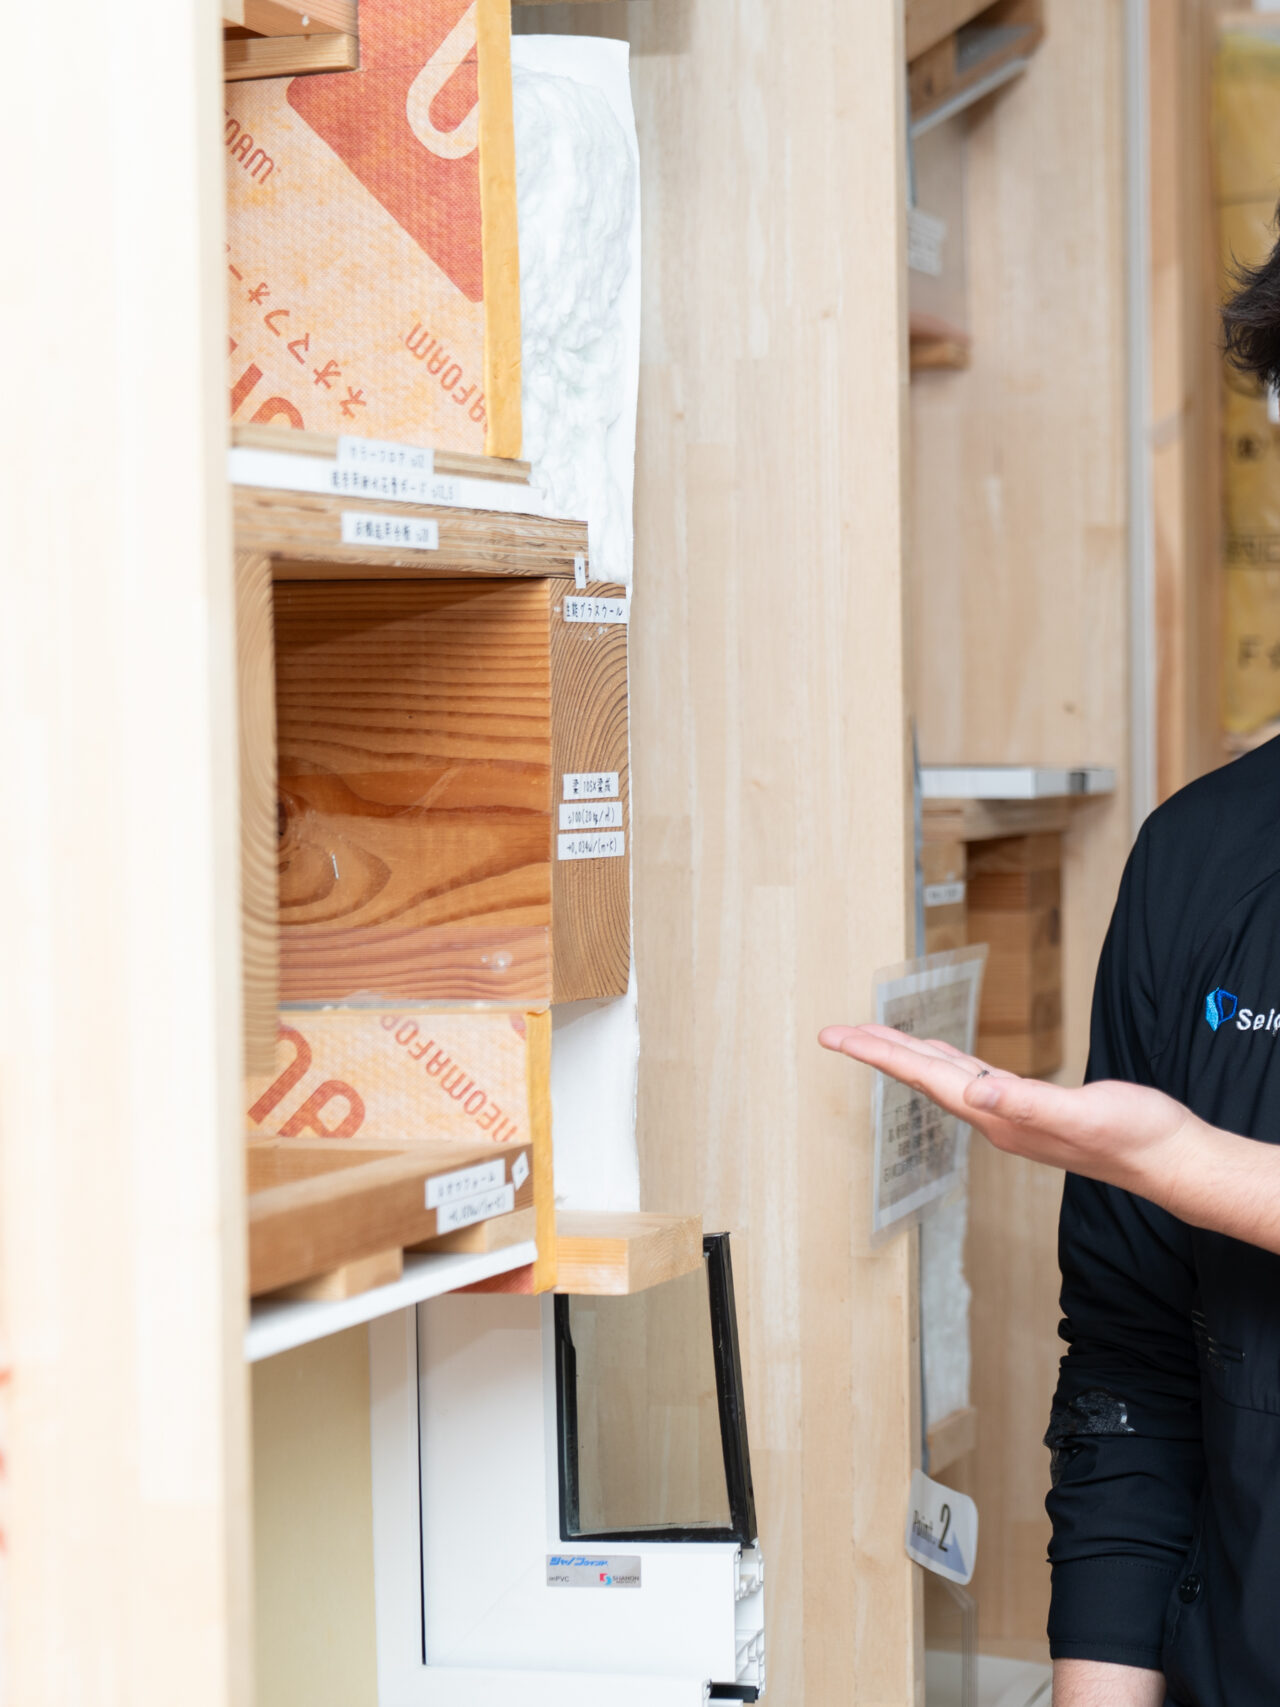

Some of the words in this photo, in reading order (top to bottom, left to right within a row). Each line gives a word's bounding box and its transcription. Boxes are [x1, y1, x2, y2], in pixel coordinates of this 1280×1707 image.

[225, 112, 274, 184] OAM
[226, 244, 367, 419] ネオマフォー
[404, 322, 488, 434] AFOAM
[938, 1504, 951, 1552] 2
